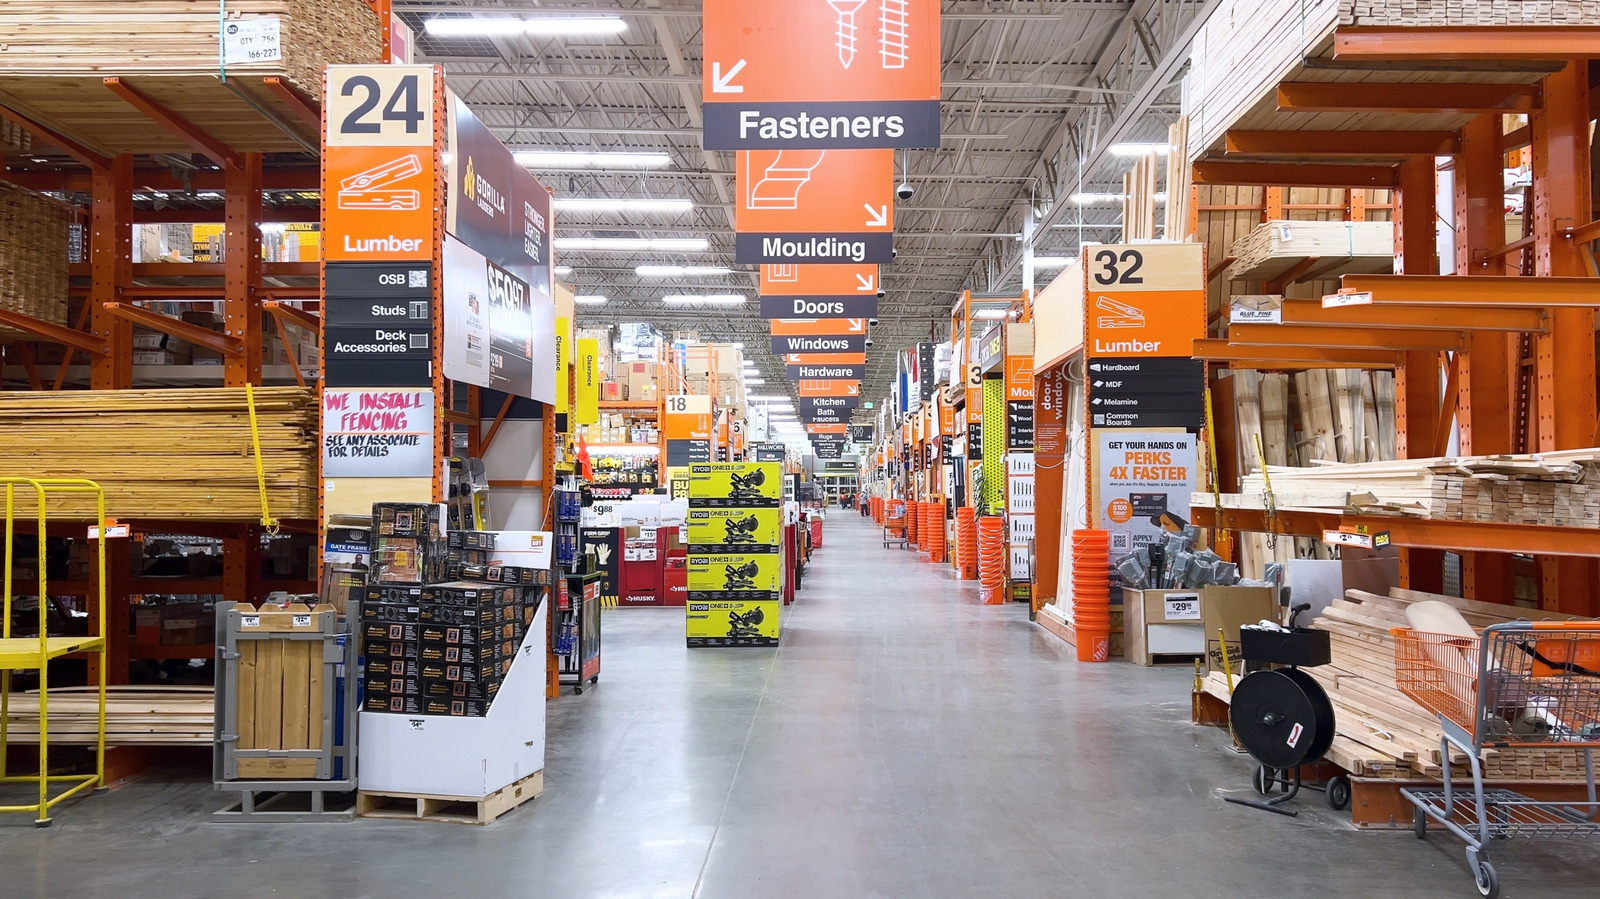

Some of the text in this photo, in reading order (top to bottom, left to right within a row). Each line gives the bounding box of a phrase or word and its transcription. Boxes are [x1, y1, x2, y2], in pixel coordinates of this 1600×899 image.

[261, 35, 276, 43] 756
[248, 48, 277, 59] 166-227
[340, 75, 424, 133] 24
[739, 110, 905, 139] Fasteners
[476, 173, 505, 215] GORILLA
[477, 195, 494, 218] LADDERS
[524, 201, 546, 233] STRONGER.
[524, 219, 542, 247] LIGHTER.
[344, 235, 423, 252] Lumber
[524, 237, 540, 263] EASIER.
[762, 238, 866, 262] Moulding
[1094, 250, 1143, 285] 32
[378, 274, 406, 285] OSB
[371, 305, 406, 316] Studs
[793, 299, 845, 314] Doors
[375, 330, 407, 340] Deck
[334, 342, 407, 353] Accessories
[787, 337, 849, 350] Windows
[1095, 338, 1161, 353] Lumber
[799, 366, 853, 377] Hardware
[1011, 387, 1034, 397] Mou
[1042, 370, 1051, 411] door &
[1052, 370, 1063, 420] window
[325, 392, 425, 411] WE INSTALL
[669, 397, 686, 411] 18
[813, 398, 845, 406] Kitchen
[817, 408, 835, 416] Bath
[341, 411, 407, 432] FENCING
[325, 434, 420, 447] SEE ANY ASSOCIATE
[1108, 441, 1187, 450] GET YOUR HANDS ON
[328, 446, 390, 458] FOR DETAILS
[1125, 451, 1171, 465] PERKS
[1109, 466, 1187, 480] 4X FASTER
[673, 480, 689, 490] BU
[1210, 646, 1240, 657] Grund
